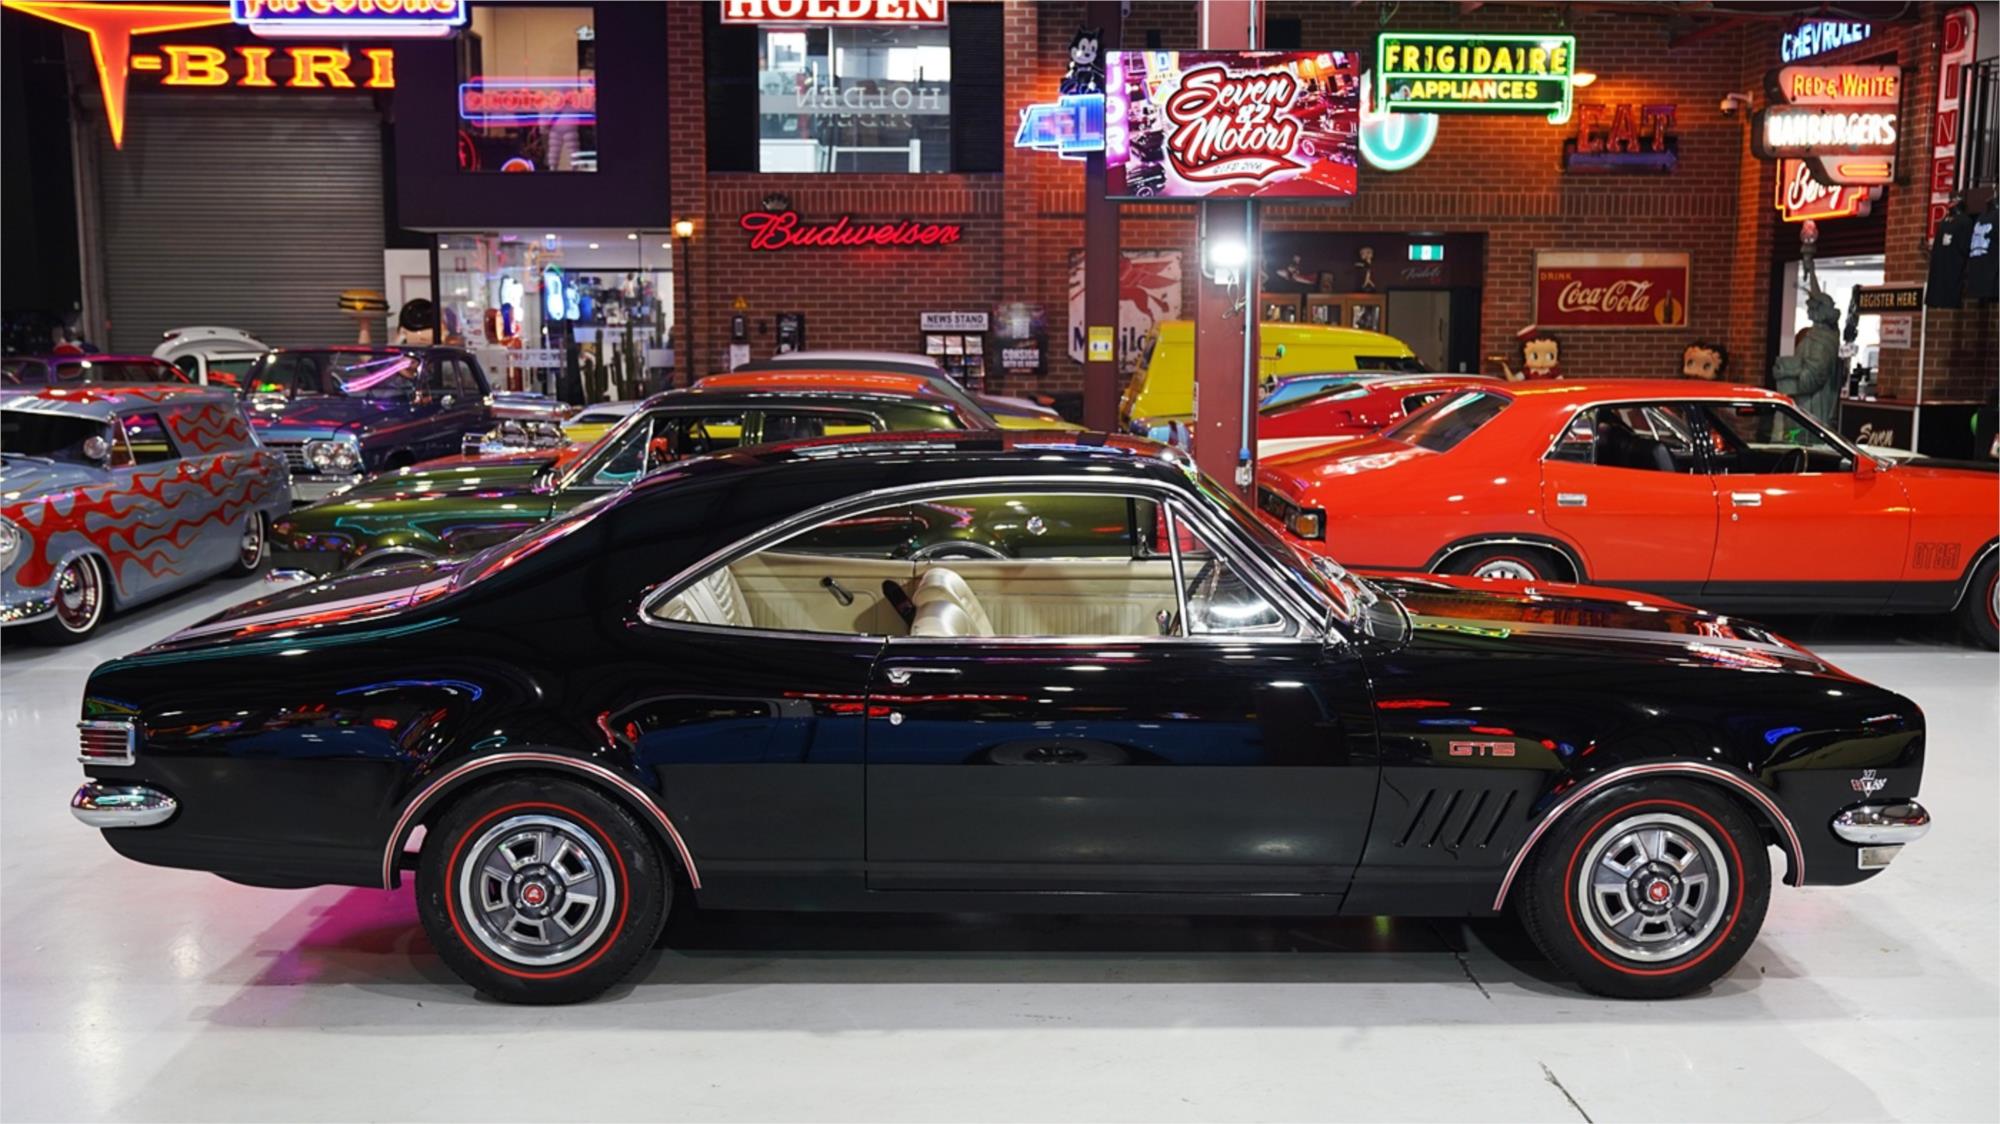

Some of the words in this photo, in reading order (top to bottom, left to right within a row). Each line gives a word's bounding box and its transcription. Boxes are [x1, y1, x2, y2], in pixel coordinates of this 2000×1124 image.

[1385, 46, 1568, 74] FRIGIDAIRE
[1173, 70, 1290, 121] Seven
[1409, 81, 1538, 100] APPLIANCES
[1794, 74, 1827, 97] RED
[1826, 79, 1838, 98] &
[1842, 73, 1895, 97] WHITE
[1174, 115, 1293, 166] Motors
[1577, 103, 1678, 154] EAT
[1767, 112, 1897, 147] HAMBURGERS
[739, 211, 961, 250] Budweiser
[1540, 272, 1573, 282] DRINK
[1557, 279, 1654, 313] Coca-Cola
[1859, 292, 1895, 308] REGISTER
[1896, 291, 1918, 307] HERE
[927, 315, 953, 324] NEWS
[954, 315, 984, 324] STAND
[1449, 740, 1516, 757] GTS
